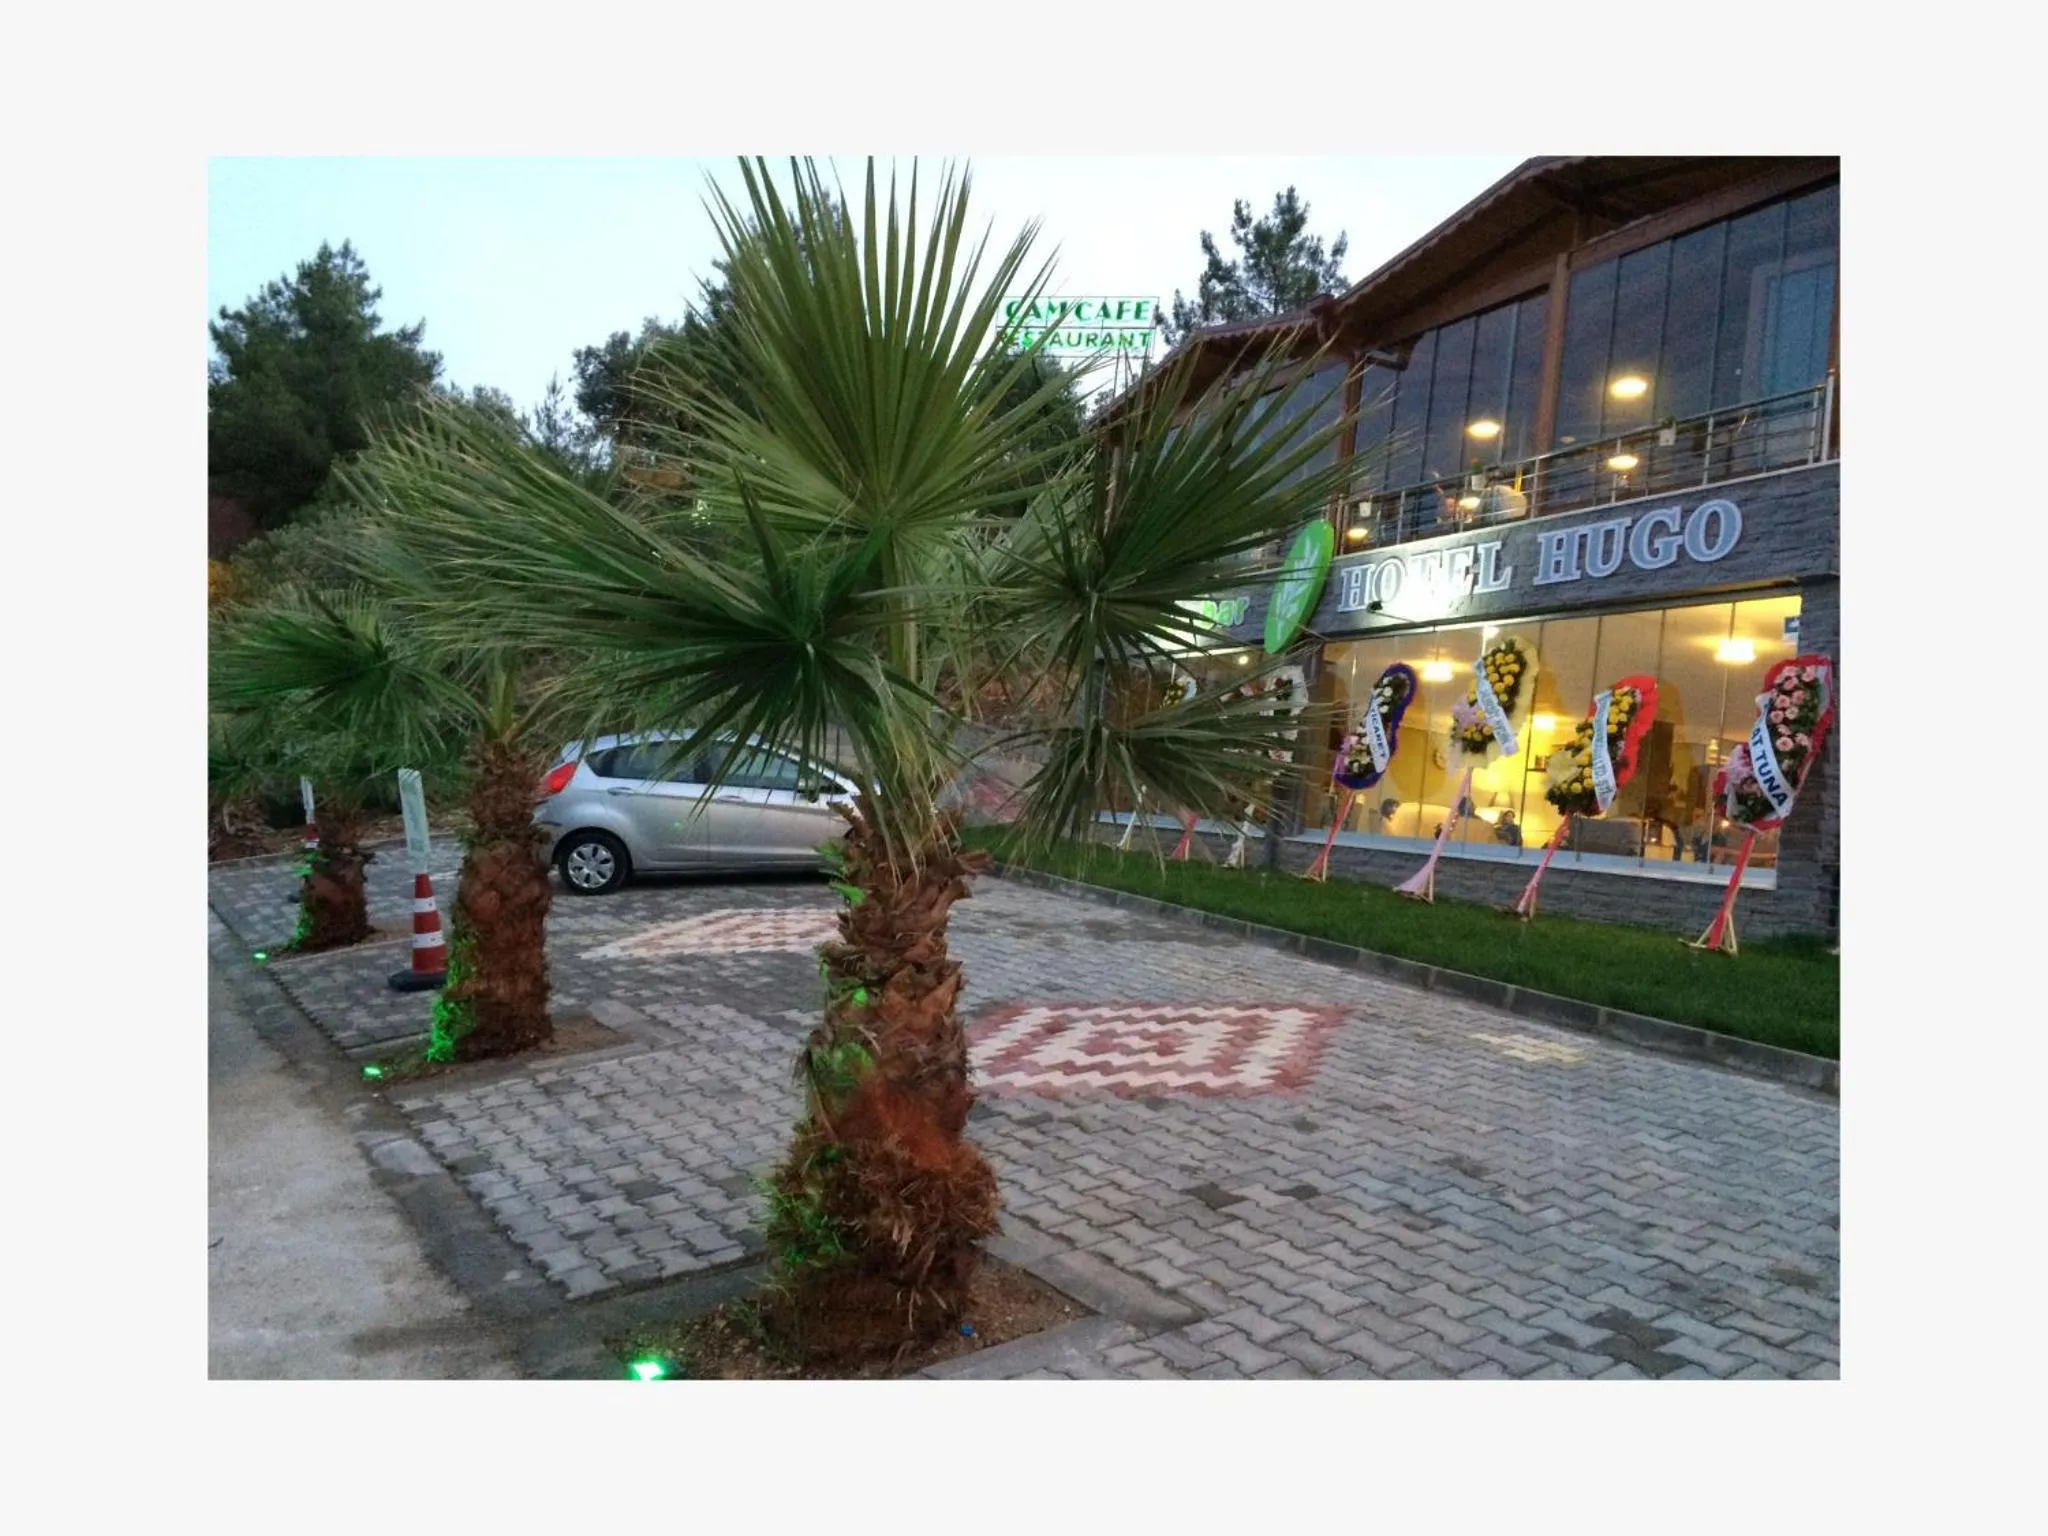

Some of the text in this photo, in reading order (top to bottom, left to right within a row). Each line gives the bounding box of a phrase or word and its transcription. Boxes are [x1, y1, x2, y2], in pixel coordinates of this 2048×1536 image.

[1074, 300, 1151, 322] CAFE
[1338, 499, 1743, 613] HOTEL HUGO
[1755, 749, 1788, 808] TUNA
